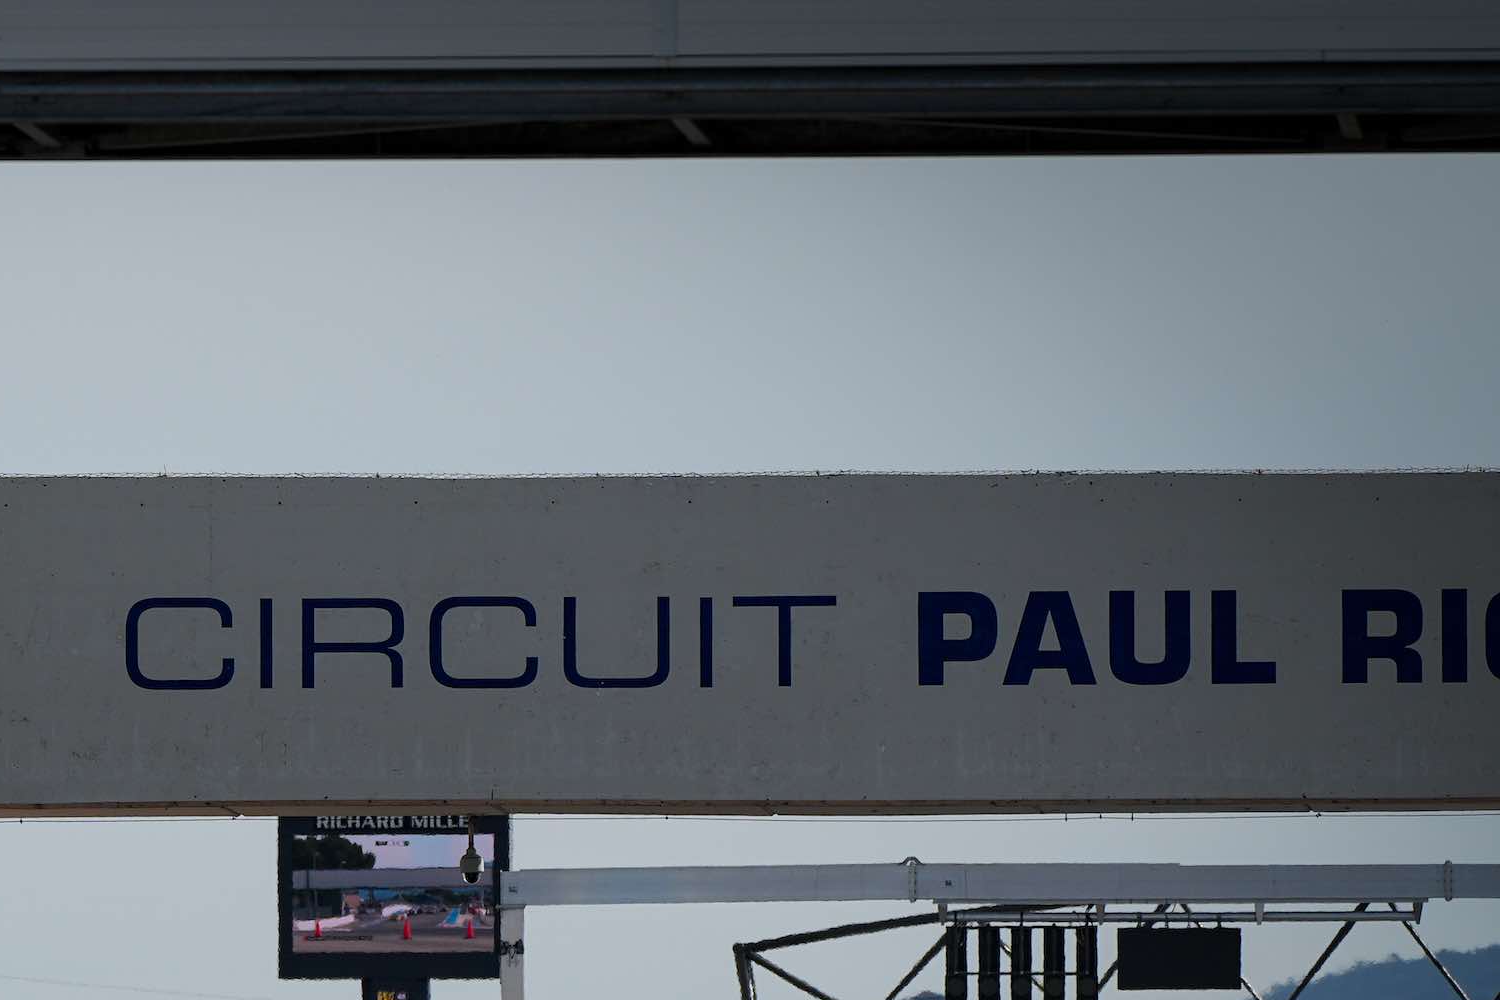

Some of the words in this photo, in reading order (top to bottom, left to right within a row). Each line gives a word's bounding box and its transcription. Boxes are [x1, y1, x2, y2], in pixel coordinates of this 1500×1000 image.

[125, 596, 838, 690] CIRCUIT
[917, 590, 1277, 687] PAUL
[1341, 589, 1500, 686] RI
[316, 815, 404, 829] RICHARD
